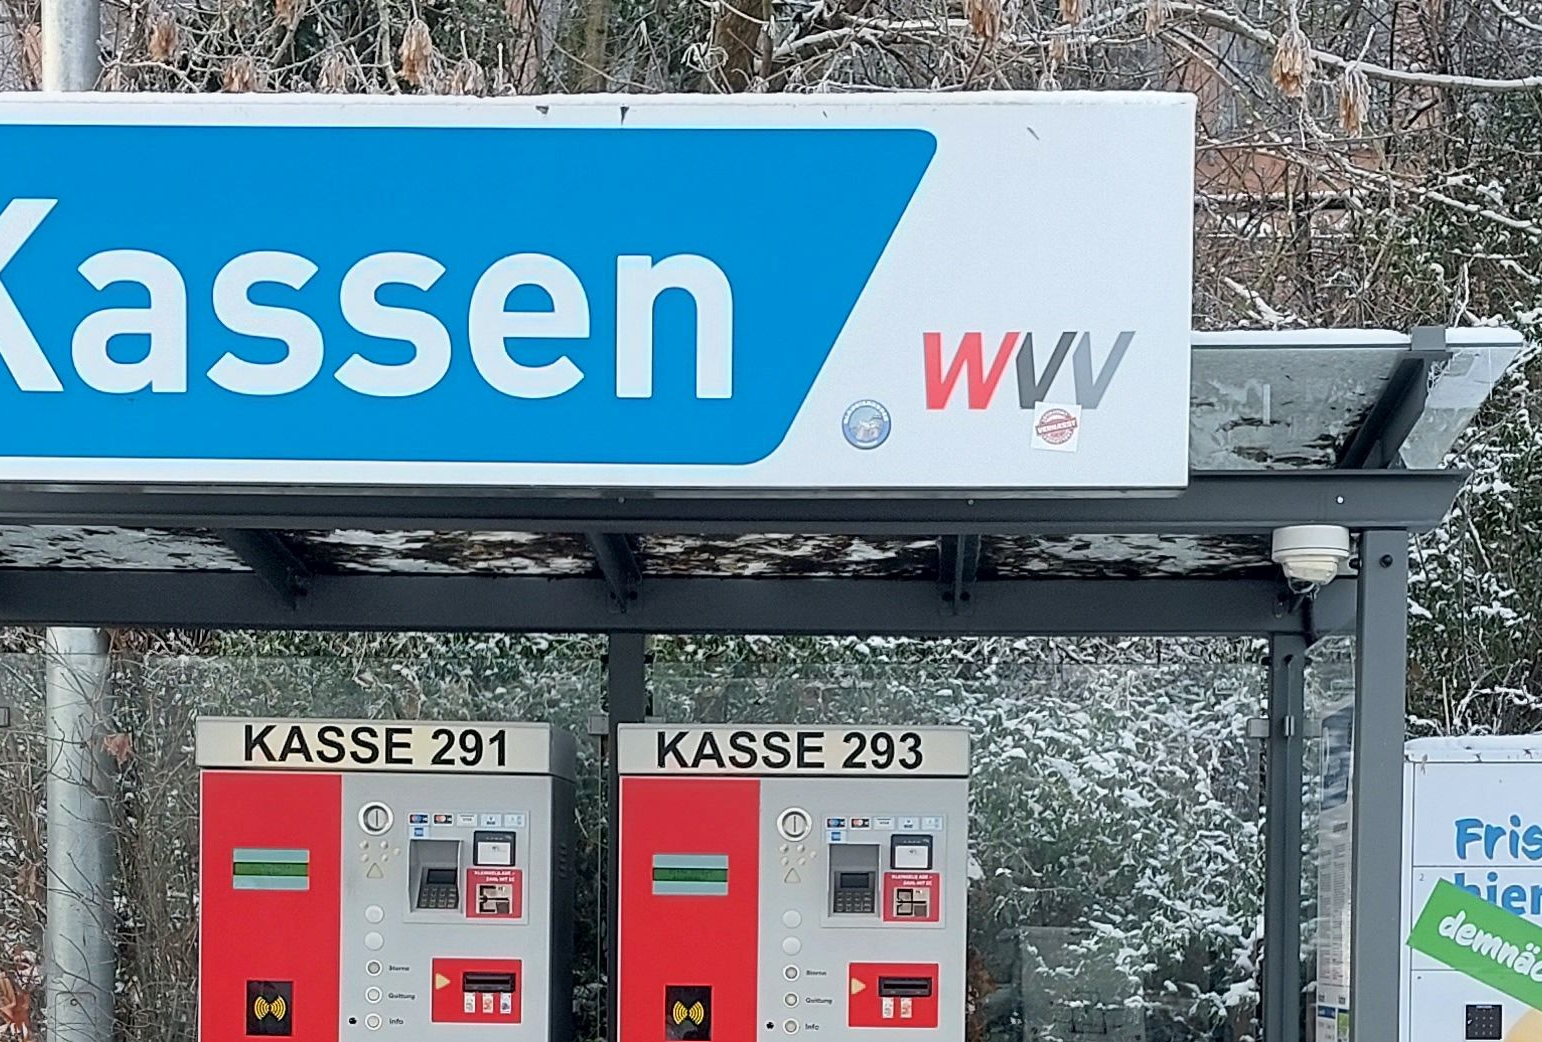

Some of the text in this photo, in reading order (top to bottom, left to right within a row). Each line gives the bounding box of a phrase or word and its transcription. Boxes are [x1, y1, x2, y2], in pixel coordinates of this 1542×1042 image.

[922, 330, 1136, 410] WVV
[243, 724, 507, 767] KASSE 291
[657, 731, 924, 769] KASSE 293
[805, 997, 833, 1005] Quittung
